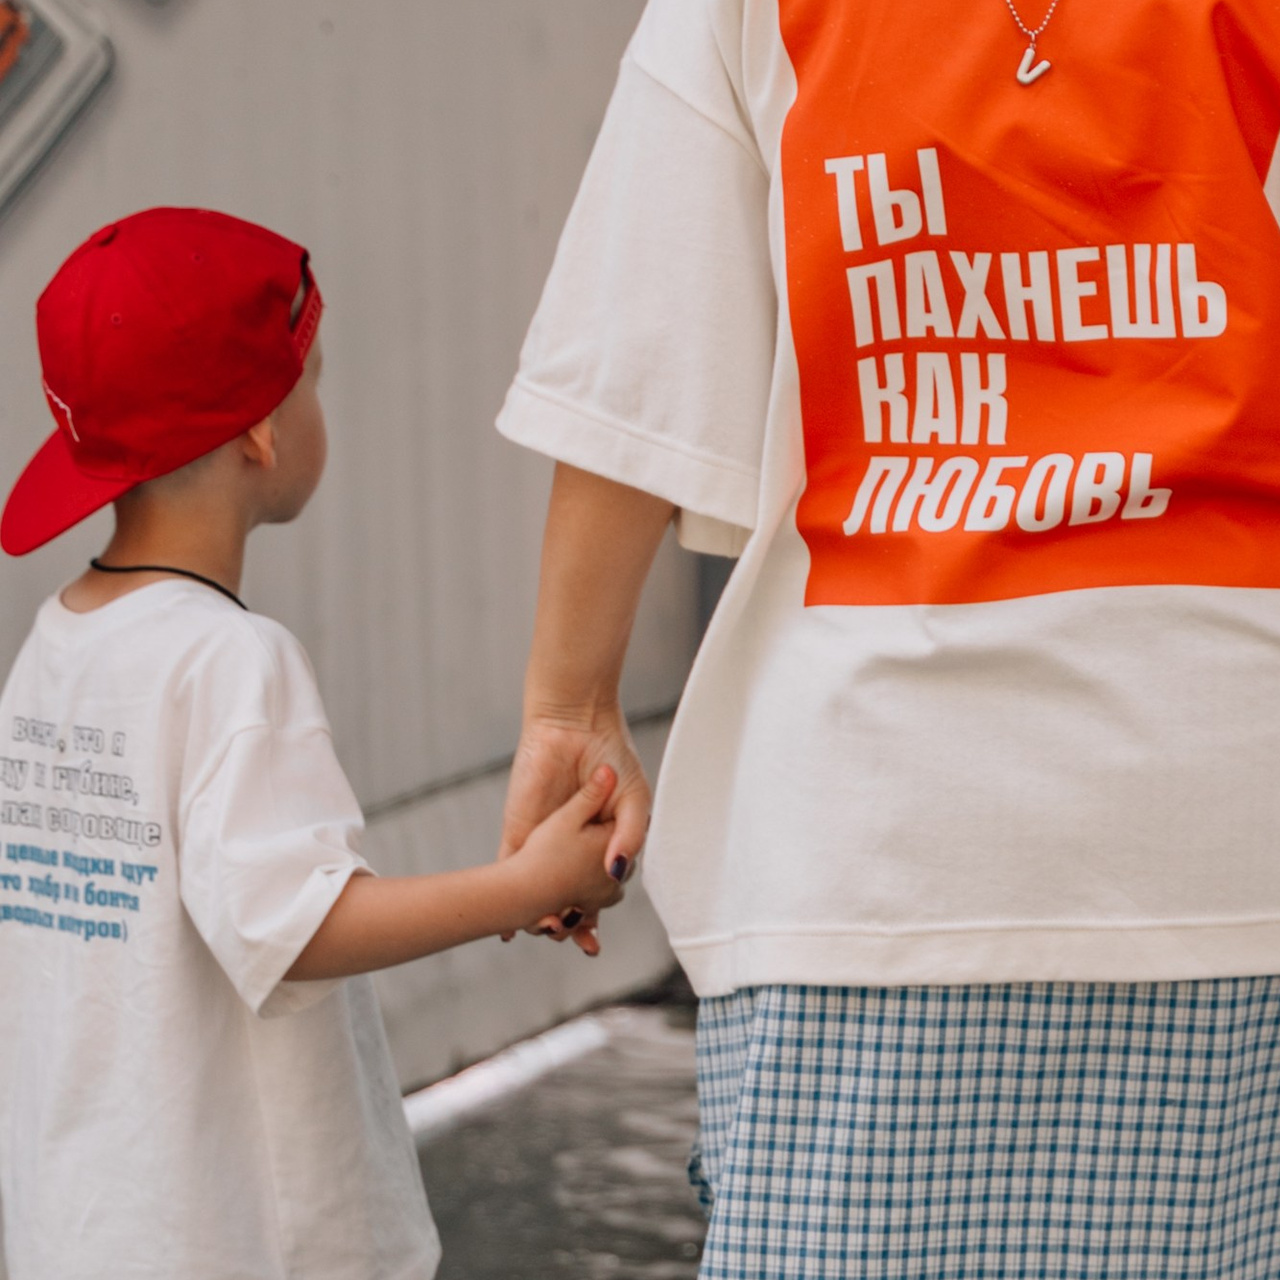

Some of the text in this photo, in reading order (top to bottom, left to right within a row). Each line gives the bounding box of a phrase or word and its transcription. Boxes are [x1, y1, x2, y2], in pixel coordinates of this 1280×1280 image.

[825, 149, 946, 252] ТЫ
[846, 243, 1227, 346] ПАХНЕШЬ
[859, 353, 1008, 445] КАК
[843, 451, 1173, 536] ЛЮБОВЬ
